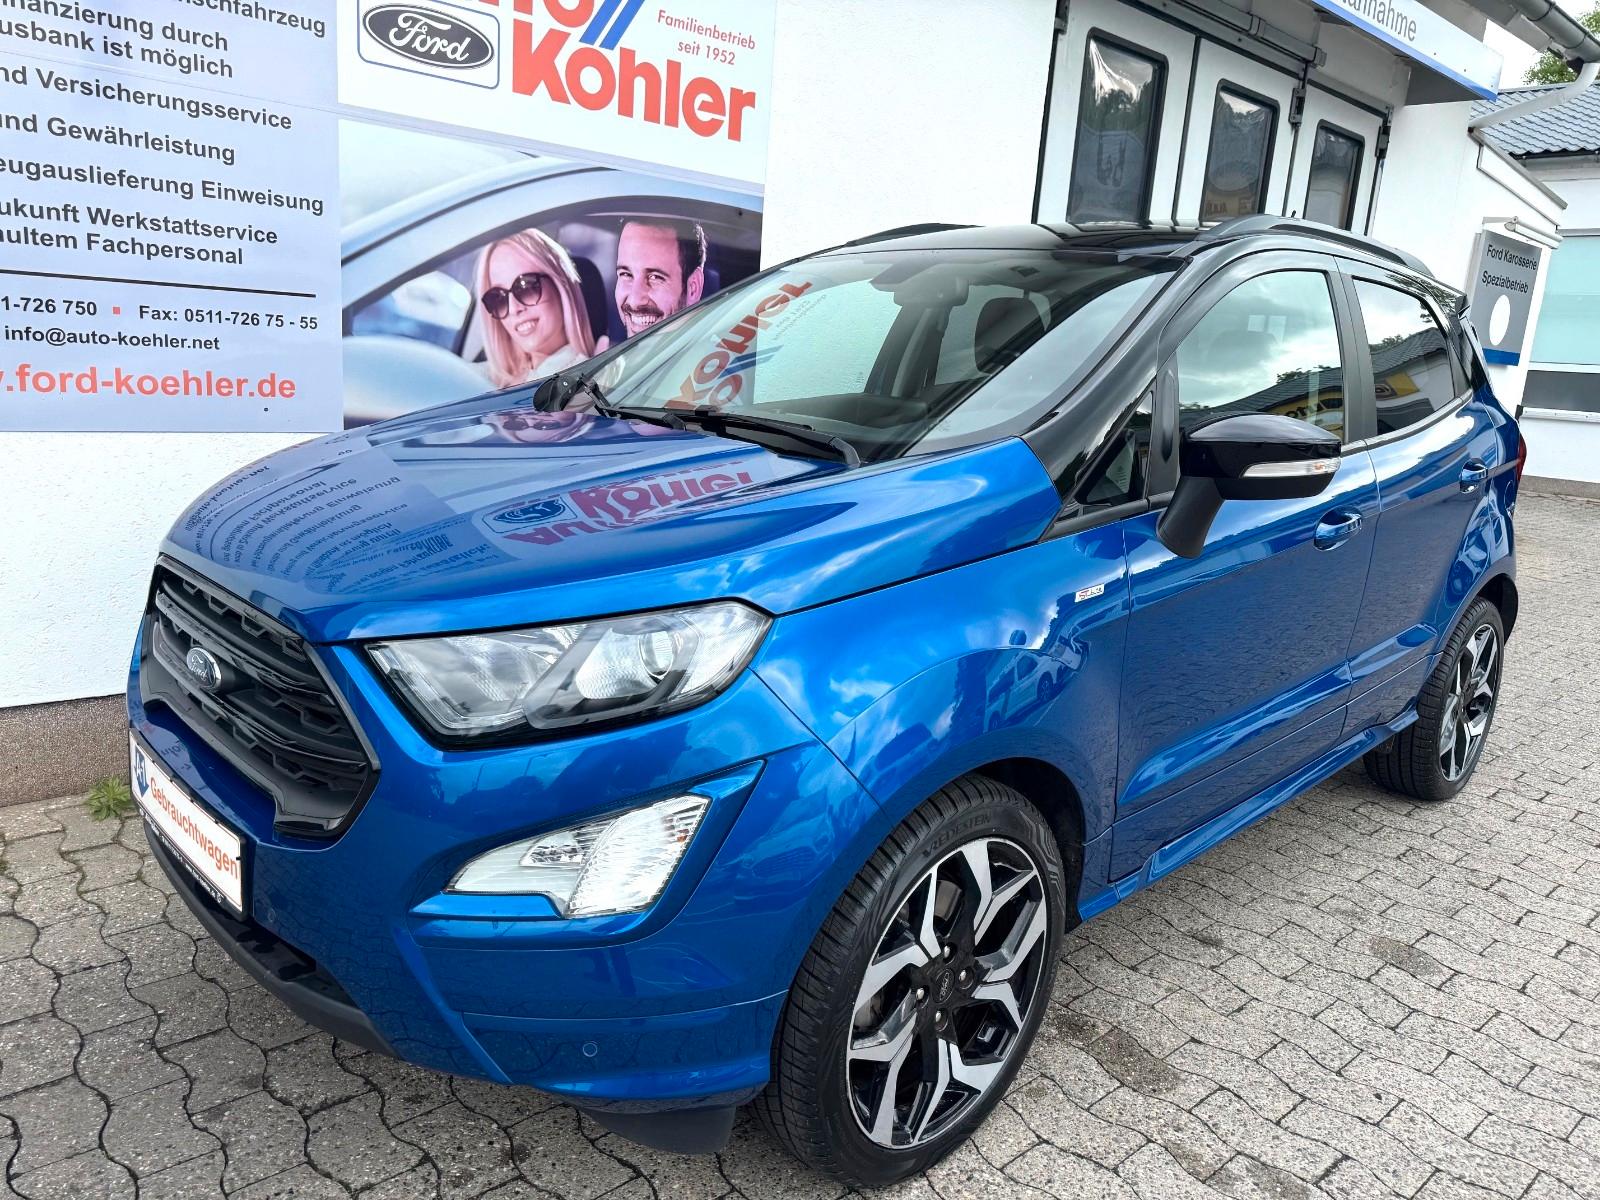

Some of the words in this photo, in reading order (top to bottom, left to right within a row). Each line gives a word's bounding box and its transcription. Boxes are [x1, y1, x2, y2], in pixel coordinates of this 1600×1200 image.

[162, 22, 229, 51] durch
[388, 12, 472, 62] Ford
[657, 9, 756, 50] Familienbetrieb
[103, 35, 134, 59] ist
[140, 47, 234, 78] möglich
[677, 40, 701, 56] seit
[706, 45, 736, 66] 1952
[35, 67, 293, 130] Versicherungsservice
[47, 116, 236, 166] Gewährleistung
[201, 180, 324, 217] Einweisung
[87, 206, 279, 244] Werkstattservice
[86, 232, 244, 265] Fachpersonal
[1486, 244, 1504, 261] Ford
[1503, 249, 1538, 271] Karosserie
[1481, 270, 1529, 294] Spezialbetrieb
[62, 299, 98, 316] 750
[139, 305, 179, 322] Fax:
[184, 308, 260, 327] 0511-726
[265, 314, 285, 328] 75
[299, 316, 319, 330] 55
[4, 325, 221, 350] info@auto-koehler.net
[150, 777, 239, 881] Gebrauchtwagen
